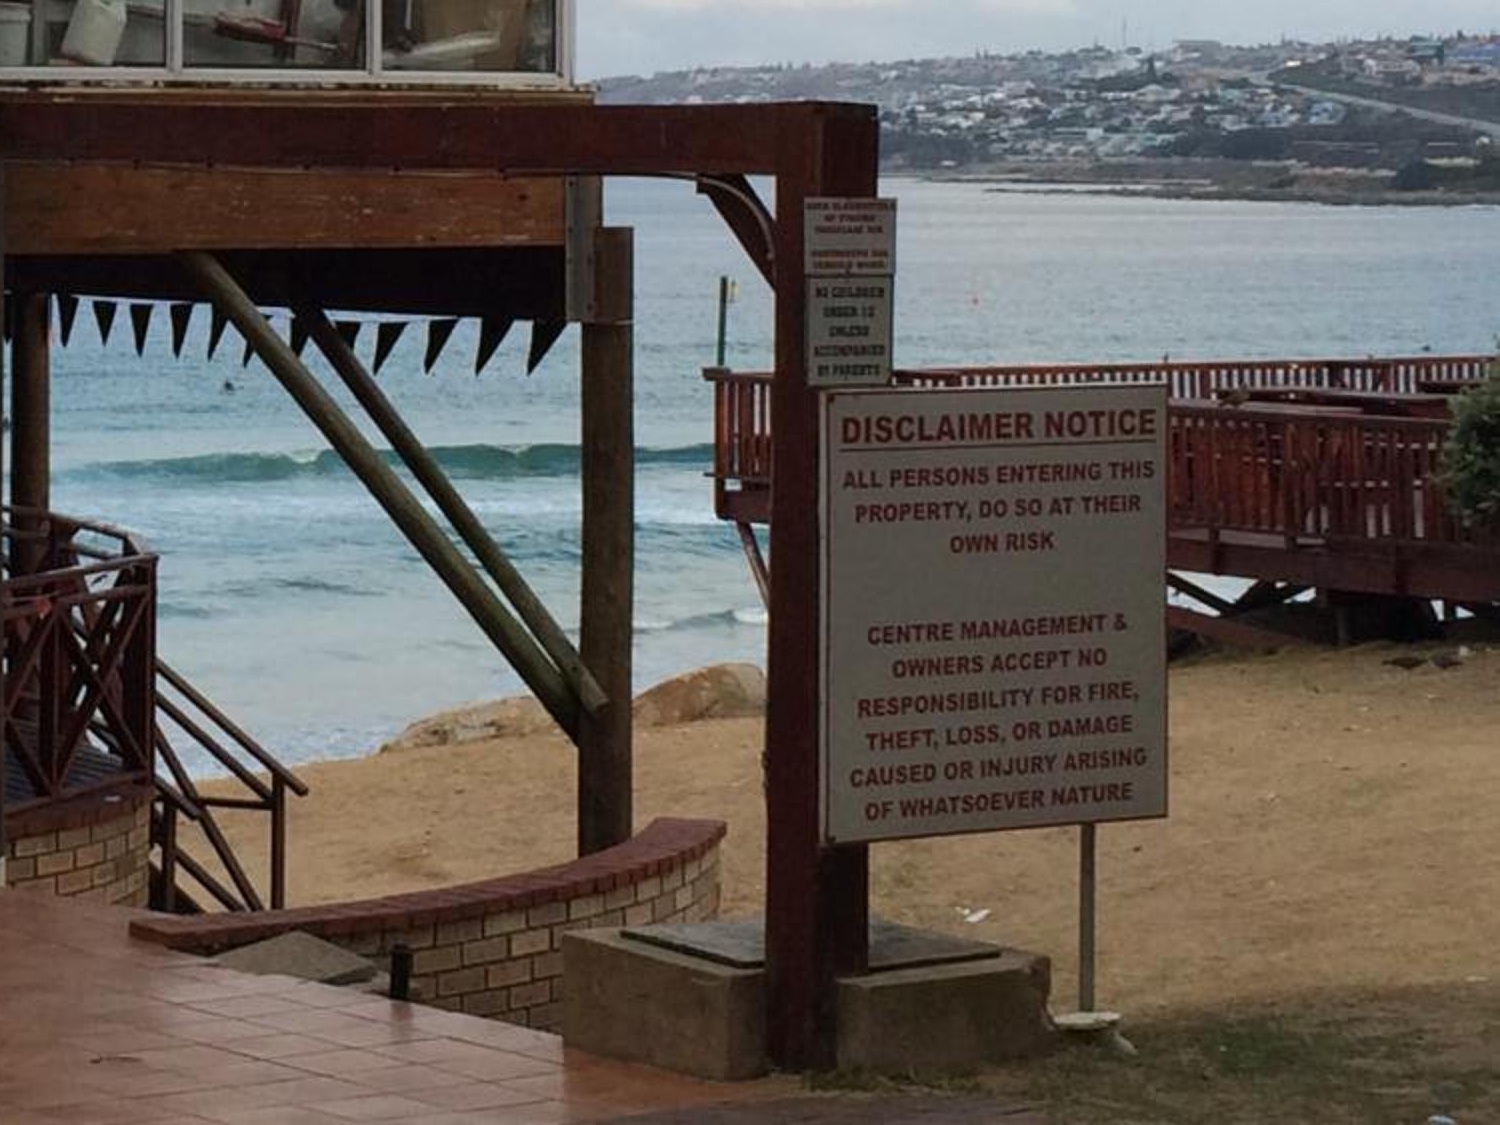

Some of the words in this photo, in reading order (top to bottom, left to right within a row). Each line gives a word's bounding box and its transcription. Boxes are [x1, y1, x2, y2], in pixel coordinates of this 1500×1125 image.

[841, 412, 1033, 444] DISCLAIMER
[1045, 409, 1156, 437] NOTICE
[843, 470, 883, 489] ALL
[889, 467, 990, 488] PERSONS
[996, 462, 1101, 485] ENTERING
[1109, 460, 1155, 479] THIS
[855, 501, 973, 524] PROPERTY,
[978, 500, 1007, 518] DO
[1014, 498, 1043, 517] SO
[1049, 496, 1075, 515] AT
[1081, 494, 1141, 513] THEIR
[949, 534, 998, 554] OWN
[1005, 531, 1055, 552] RISK
[868, 622, 954, 645] CENTRE
[960, 614, 1109, 640] MANAGEMENT
[1113, 613, 1127, 631] &
[893, 654, 984, 678] OWNERS
[991, 650, 1071, 672] ACCEPT
[1078, 648, 1107, 668] NO
[858, 687, 1035, 718] RESPONSIBILITY
[1042, 685, 1081, 705] FOR
[1088, 682, 1139, 702] FIRE,
[866, 729, 939, 751] THEFT,
[946, 724, 1007, 746] LOSS,
[1012, 722, 1043, 741] OR
[1048, 715, 1133, 737] DAMAGE
[850, 764, 937, 788] CAUSED
[944, 760, 974, 780] OR
[980, 755, 1057, 778] INJURY
[1063, 747, 1147, 771] ARISING
[865, 800, 893, 820] OF
[899, 790, 1046, 818] WHATSOEVER
[1051, 782, 1134, 805] NATURE
